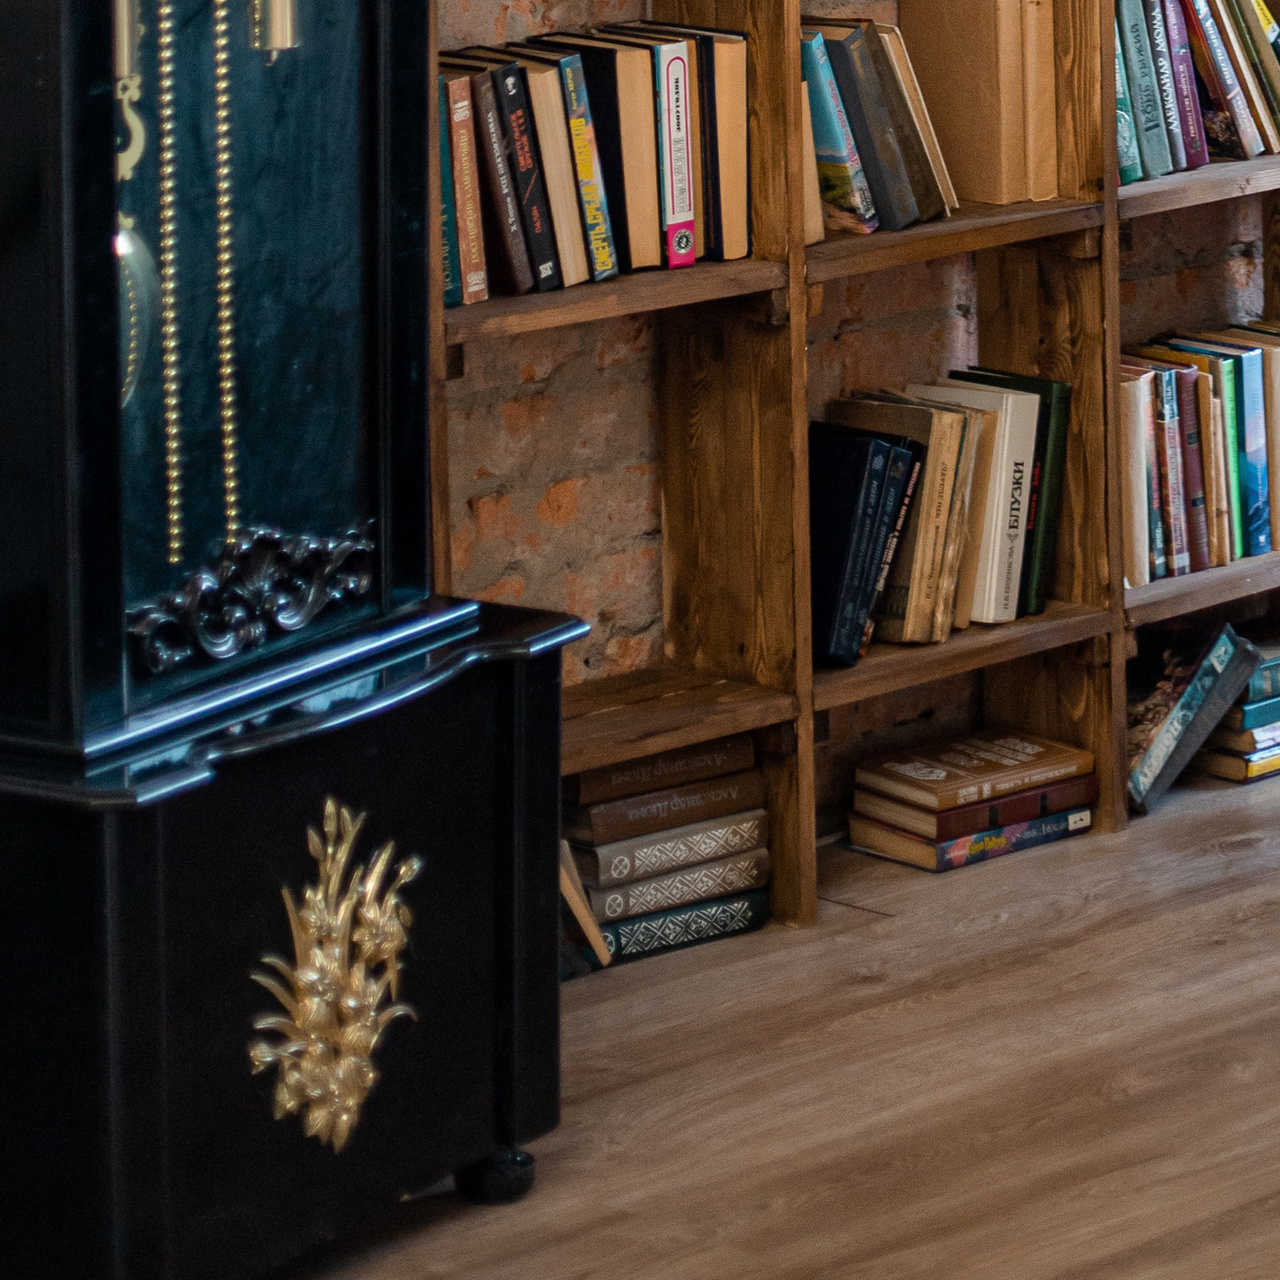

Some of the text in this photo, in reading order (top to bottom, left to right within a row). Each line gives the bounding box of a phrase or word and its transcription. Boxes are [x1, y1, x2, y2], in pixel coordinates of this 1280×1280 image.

[1130, 23, 1148, 79] РЫЖИЙ
[1151, 8, 1168, 52] ДЮМА
[1214, 48, 1233, 85] ВМЕСТО
[673, 77, 682, 133] ЗООУГОЛОК
[1158, 57, 1180, 133] АЛЕКСАНДР
[582, 184, 604, 223] СРЕДИ
[592, 225, 614, 272] СМЕРТЬ
[1007, 462, 1026, 531] БЛУЗКИ
